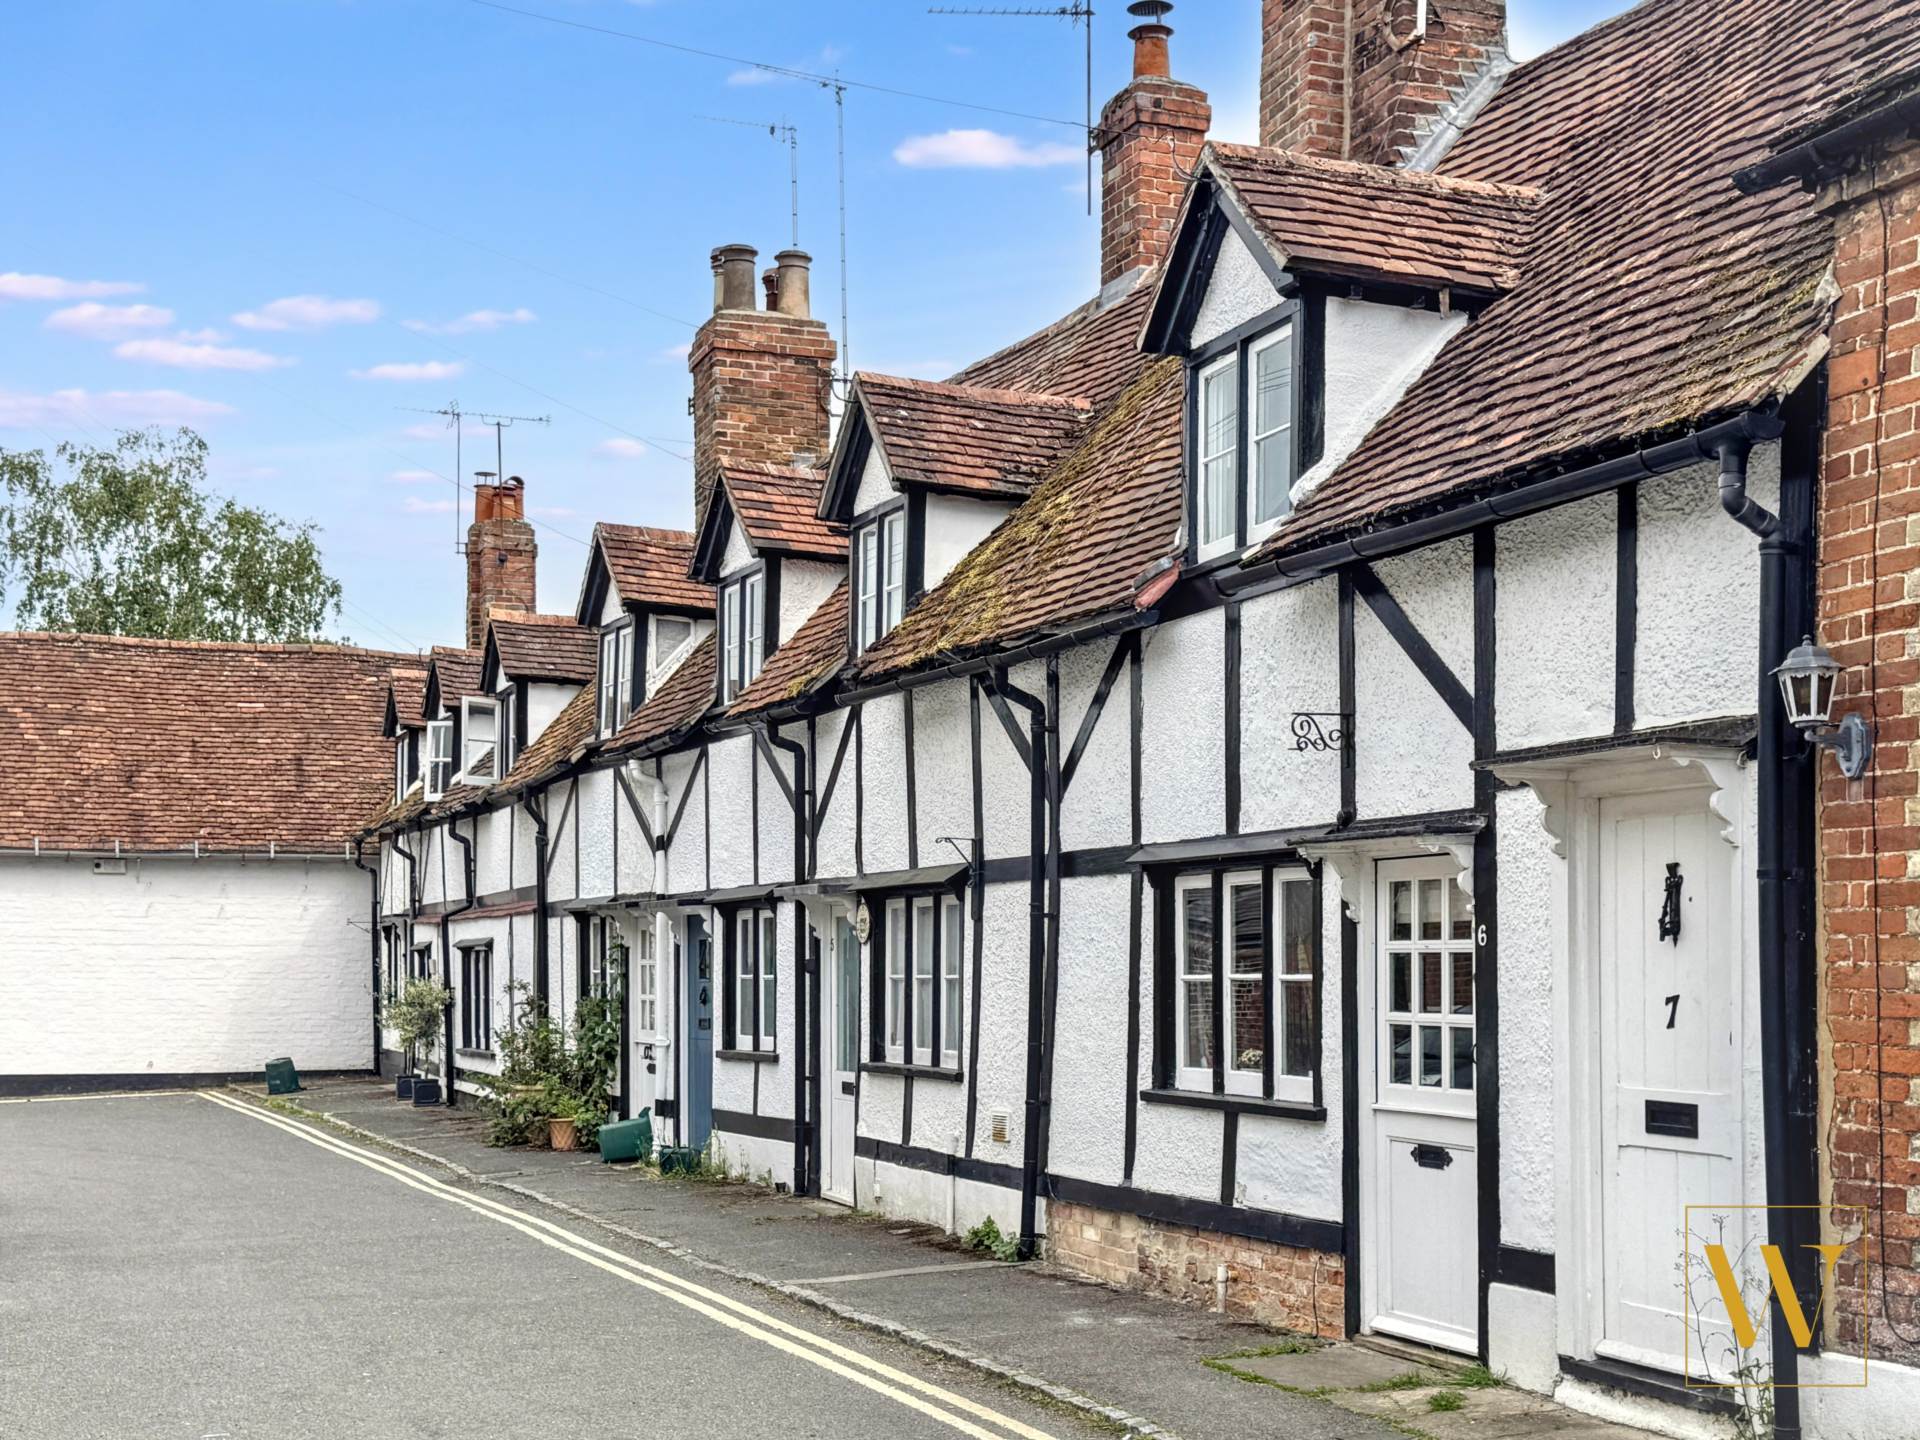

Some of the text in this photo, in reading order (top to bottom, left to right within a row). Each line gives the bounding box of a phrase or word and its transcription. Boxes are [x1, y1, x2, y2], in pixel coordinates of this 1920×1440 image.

[829, 937, 835, 951] 5
[1478, 924, 1487, 946] 6
[1665, 994, 1680, 1030] 7
